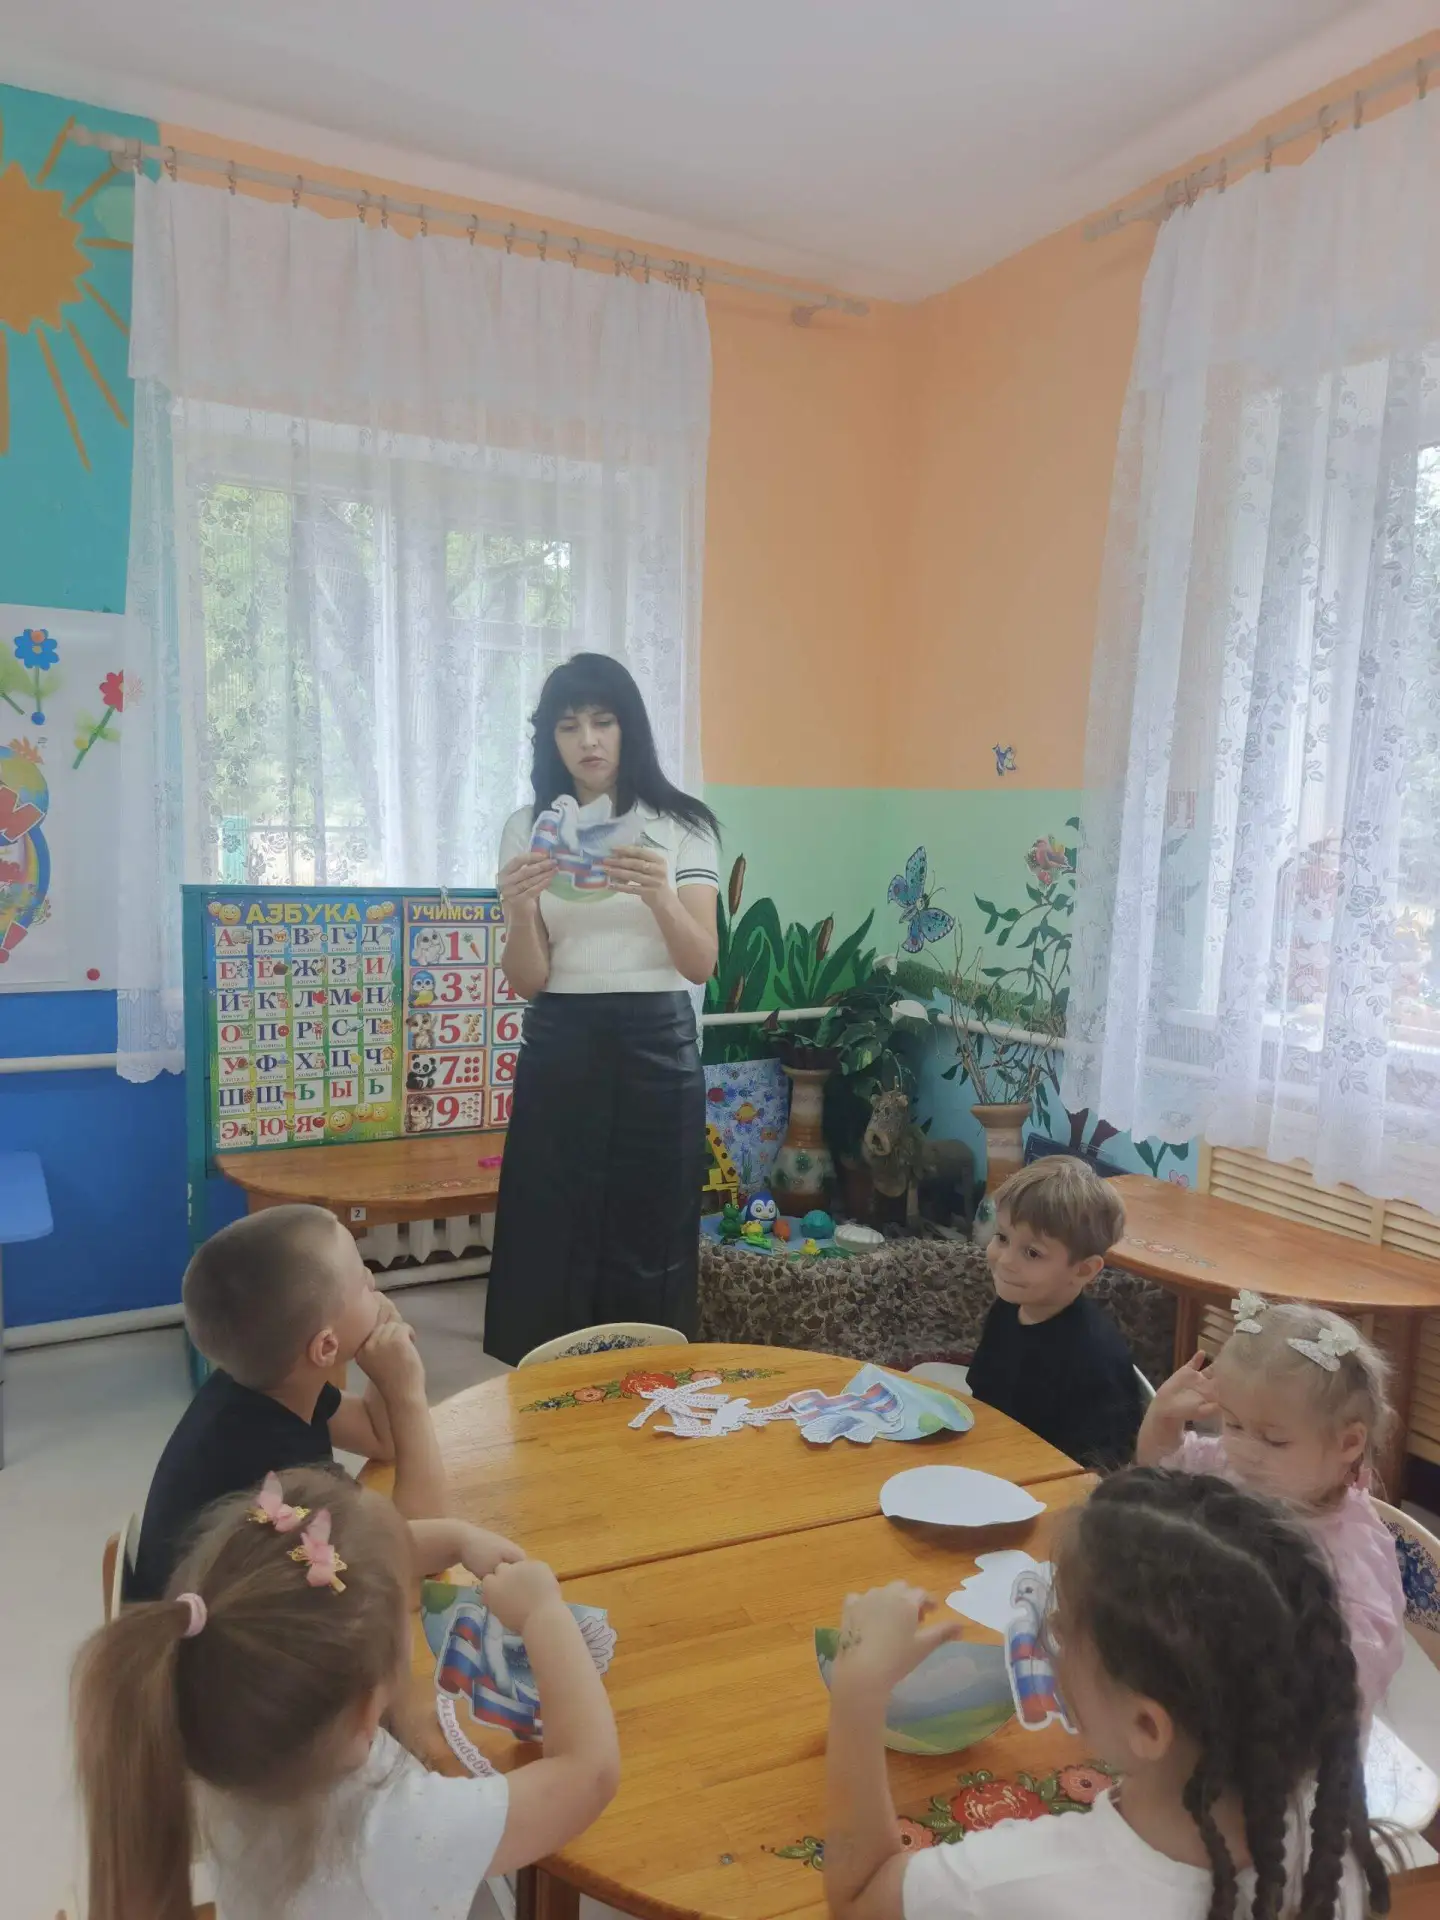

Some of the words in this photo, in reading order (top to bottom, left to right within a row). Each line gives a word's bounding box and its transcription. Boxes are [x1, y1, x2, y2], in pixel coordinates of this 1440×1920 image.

[245, 903, 361, 924] АЗБУКА
[412, 905, 484, 920] УЧИМСЯ
[490, 905, 504, 920] С
[217, 929, 236, 946] А
[256, 928, 273, 945] Б
[292, 928, 310, 945] В
[330, 927, 346, 944] Г
[361, 926, 379, 945] Д
[445, 931, 463, 960] 1
[219, 962, 237, 979] Е
[256, 955, 274, 979] Ё
[291, 959, 319, 977] Ж
[331, 958, 346, 975] З
[364, 957, 384, 975] И
[219, 988, 241, 1012] Й
[257, 991, 276, 1010] К
[294, 991, 314, 1008] Л
[329, 989, 352, 1006] М
[364, 987, 384, 1004] Н
[440, 972, 463, 1002] 3
[221, 1024, 241, 1043] О
[257, 1023, 277, 1041] П
[296, 1021, 313, 1039] Р
[331, 1019, 348, 1037] С
[365, 1017, 382, 1035] Т
[438, 1014, 461, 1044] 5
[496, 1012, 519, 1041] 6
[222, 1057, 240, 1075] У
[255, 1054, 277, 1072] Ф
[296, 1052, 314, 1070] Х
[331, 1049, 352, 1070] Ц
[365, 1048, 383, 1065] Ч
[439, 1055, 460, 1085] 7
[495, 1052, 517, 1081] 8
[218, 1088, 245, 1107] Ш
[256, 1085, 284, 1105] Щ
[294, 1083, 315, 1101] Ъ
[331, 1080, 353, 1098] Ы
[368, 1078, 384, 1095] Ь
[436, 1096, 460, 1126] 9
[221, 1121, 239, 1139] Э
[259, 1117, 285, 1136] Ю
[295, 1116, 312, 1133] Я
[355, 1209, 361, 1218] 2
